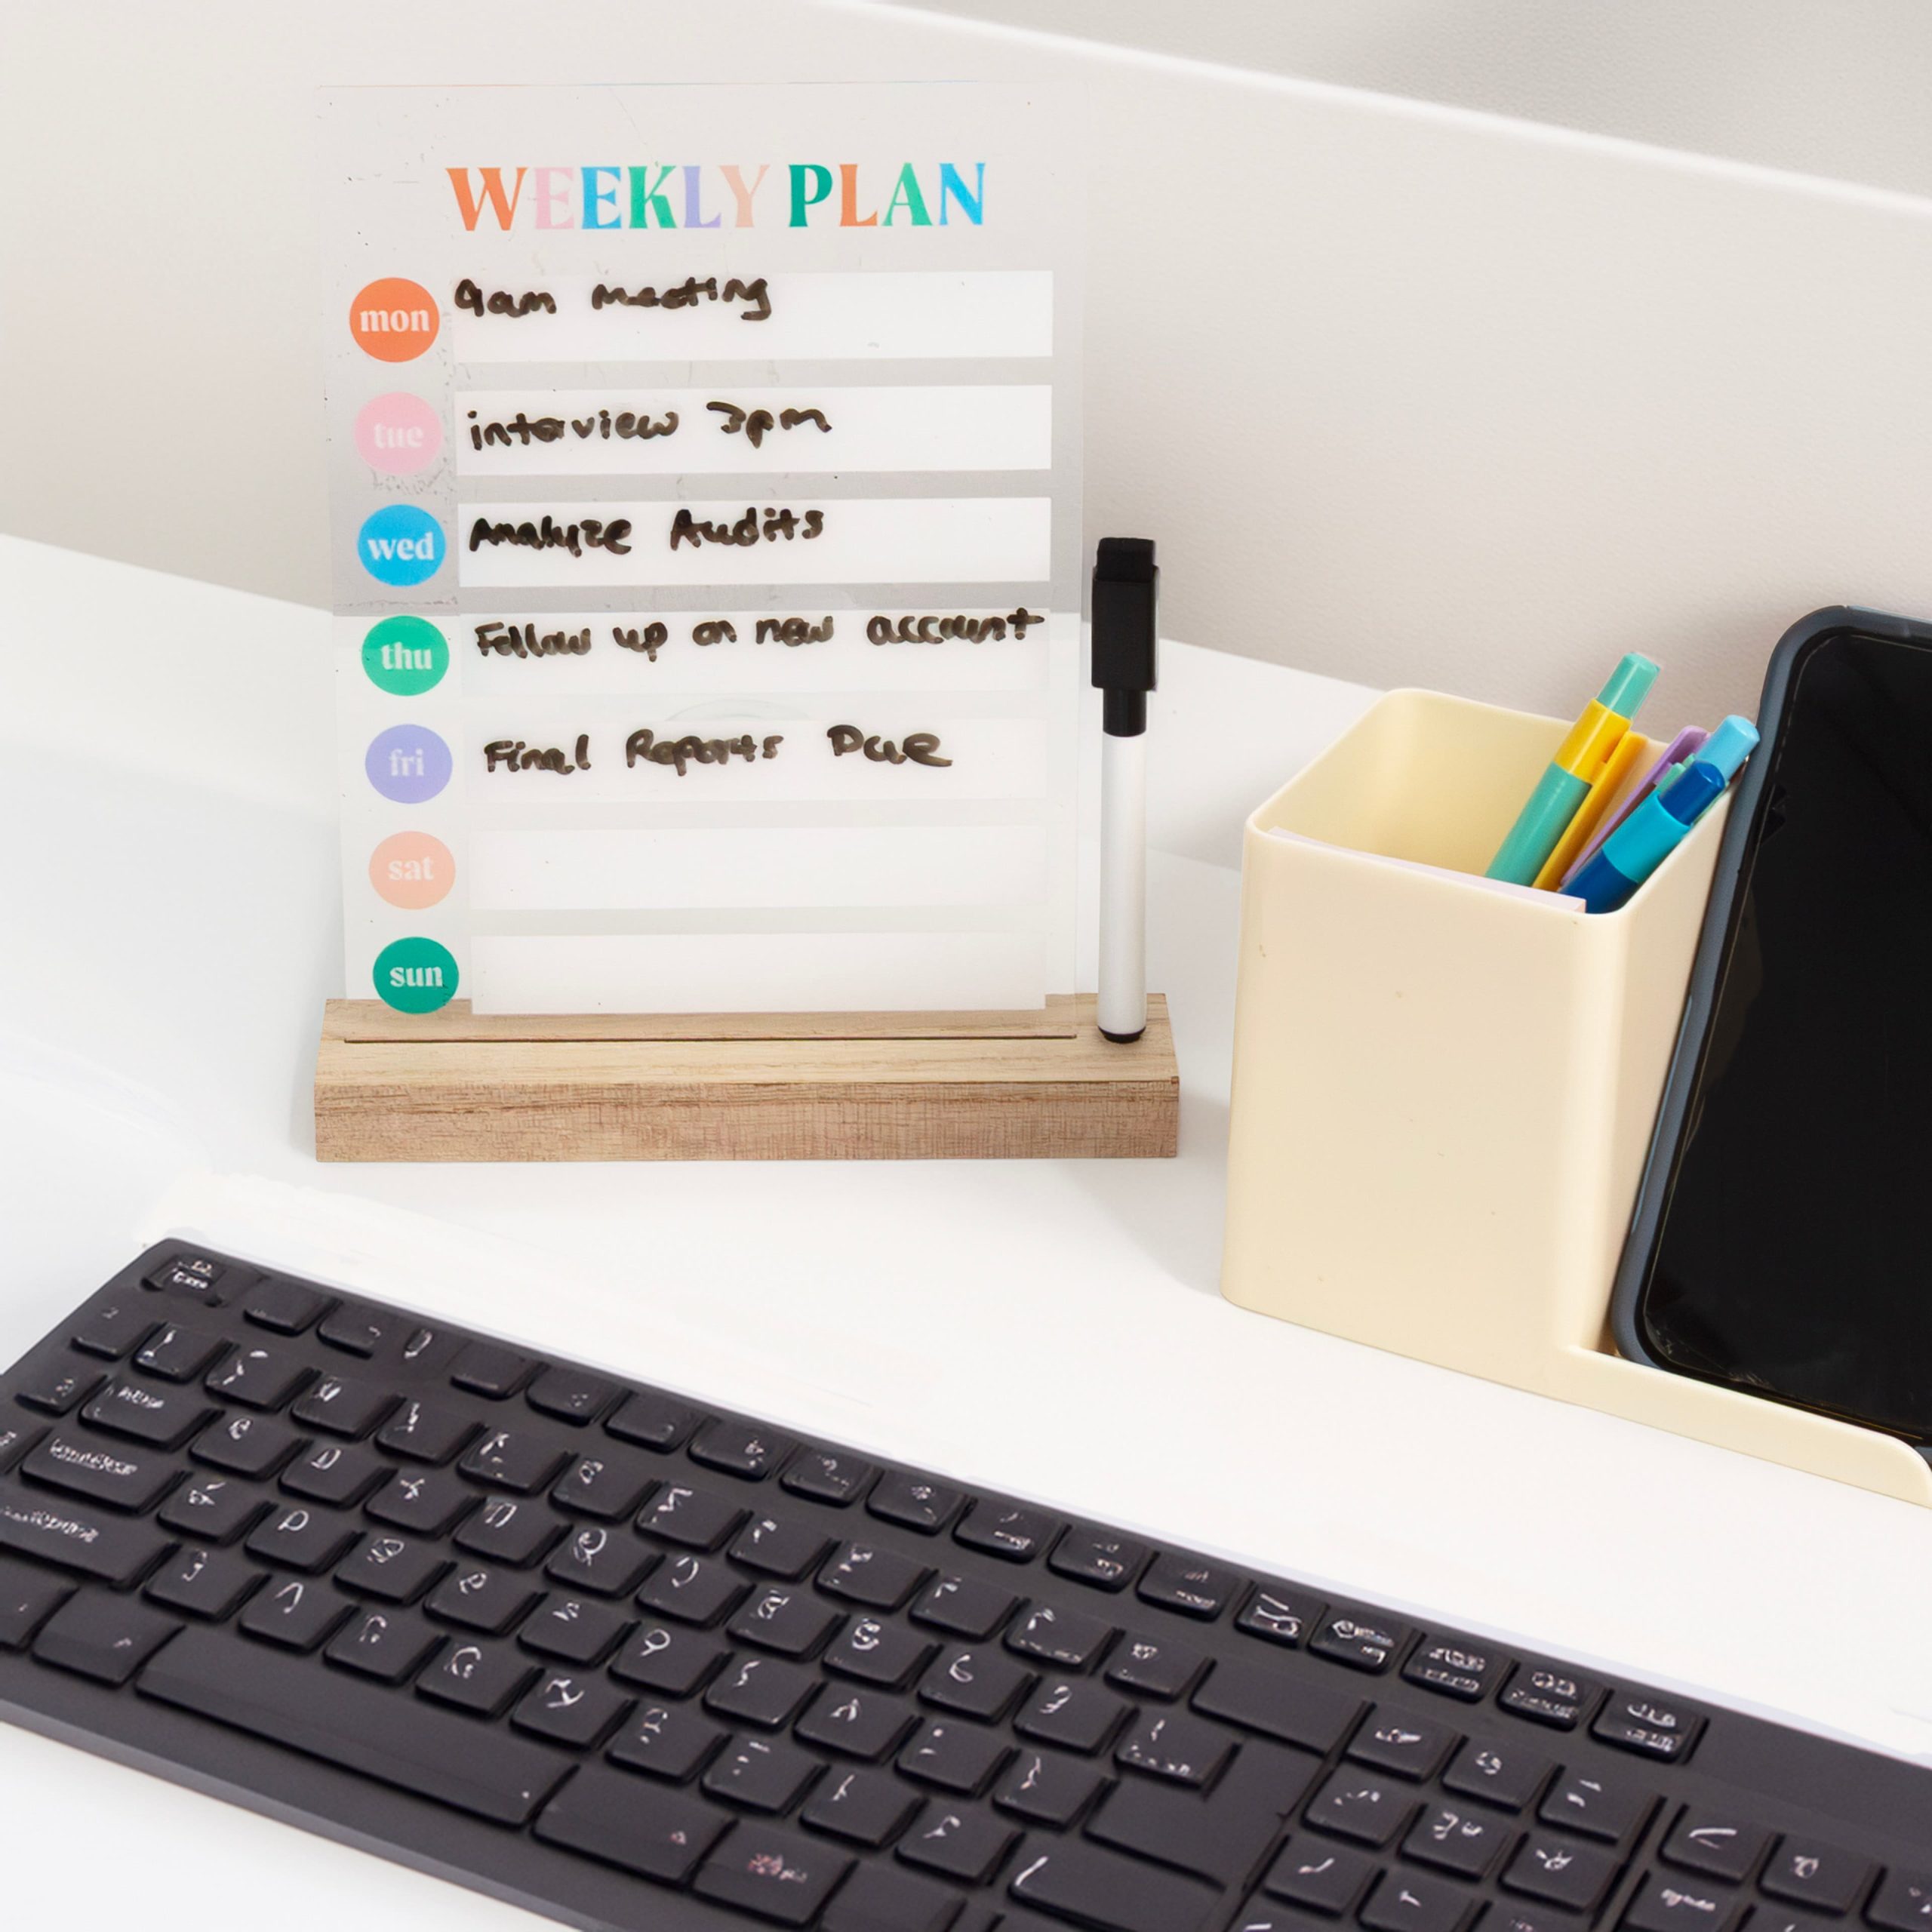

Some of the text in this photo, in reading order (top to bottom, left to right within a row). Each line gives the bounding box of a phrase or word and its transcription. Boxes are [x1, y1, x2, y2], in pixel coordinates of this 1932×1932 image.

[445, 161, 986, 231] WEEKLY PLAN
[454, 275, 772, 321] 9am meeting
[359, 308, 430, 333] mon
[373, 423, 423, 449] tue
[466, 400, 833, 451] interview 3pm
[368, 531, 435, 561] wed
[468, 506, 825, 558] Analyze Audits
[473, 607, 1046, 663] Follow up on new account
[380, 641, 432, 670] thu
[389, 749, 424, 776] fri
[483, 724, 952, 777] Final Reports Due
[388, 857, 434, 881] sat
[389, 966, 444, 988] sun
